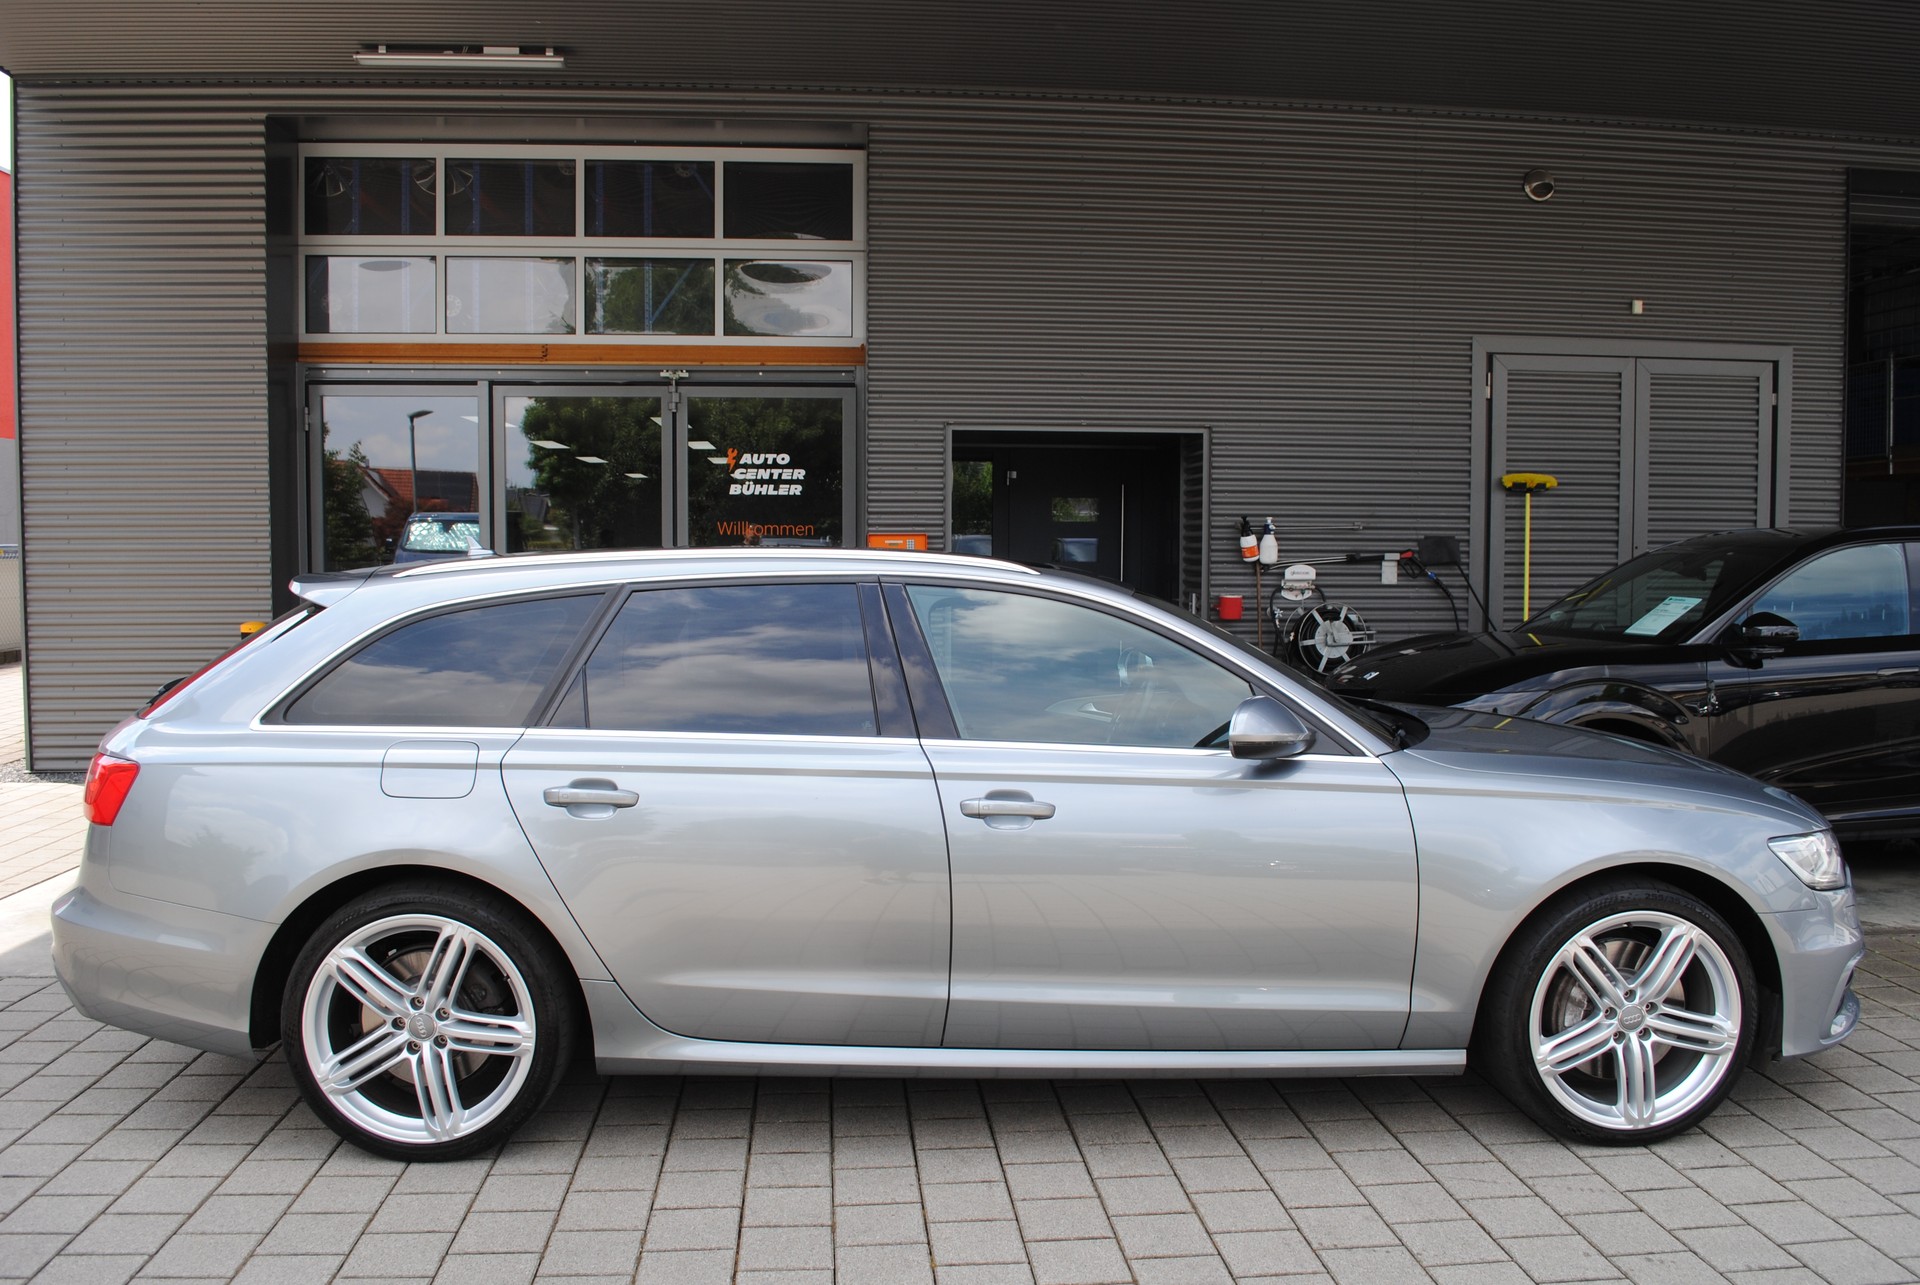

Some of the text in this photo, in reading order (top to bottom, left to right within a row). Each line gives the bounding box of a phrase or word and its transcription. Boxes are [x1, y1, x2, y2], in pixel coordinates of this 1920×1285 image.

[739, 453, 790, 465] AUTO
[730, 468, 806, 480] CENTER
[729, 481, 802, 495] BÜHLER
[717, 521, 814, 536] Willkommen
